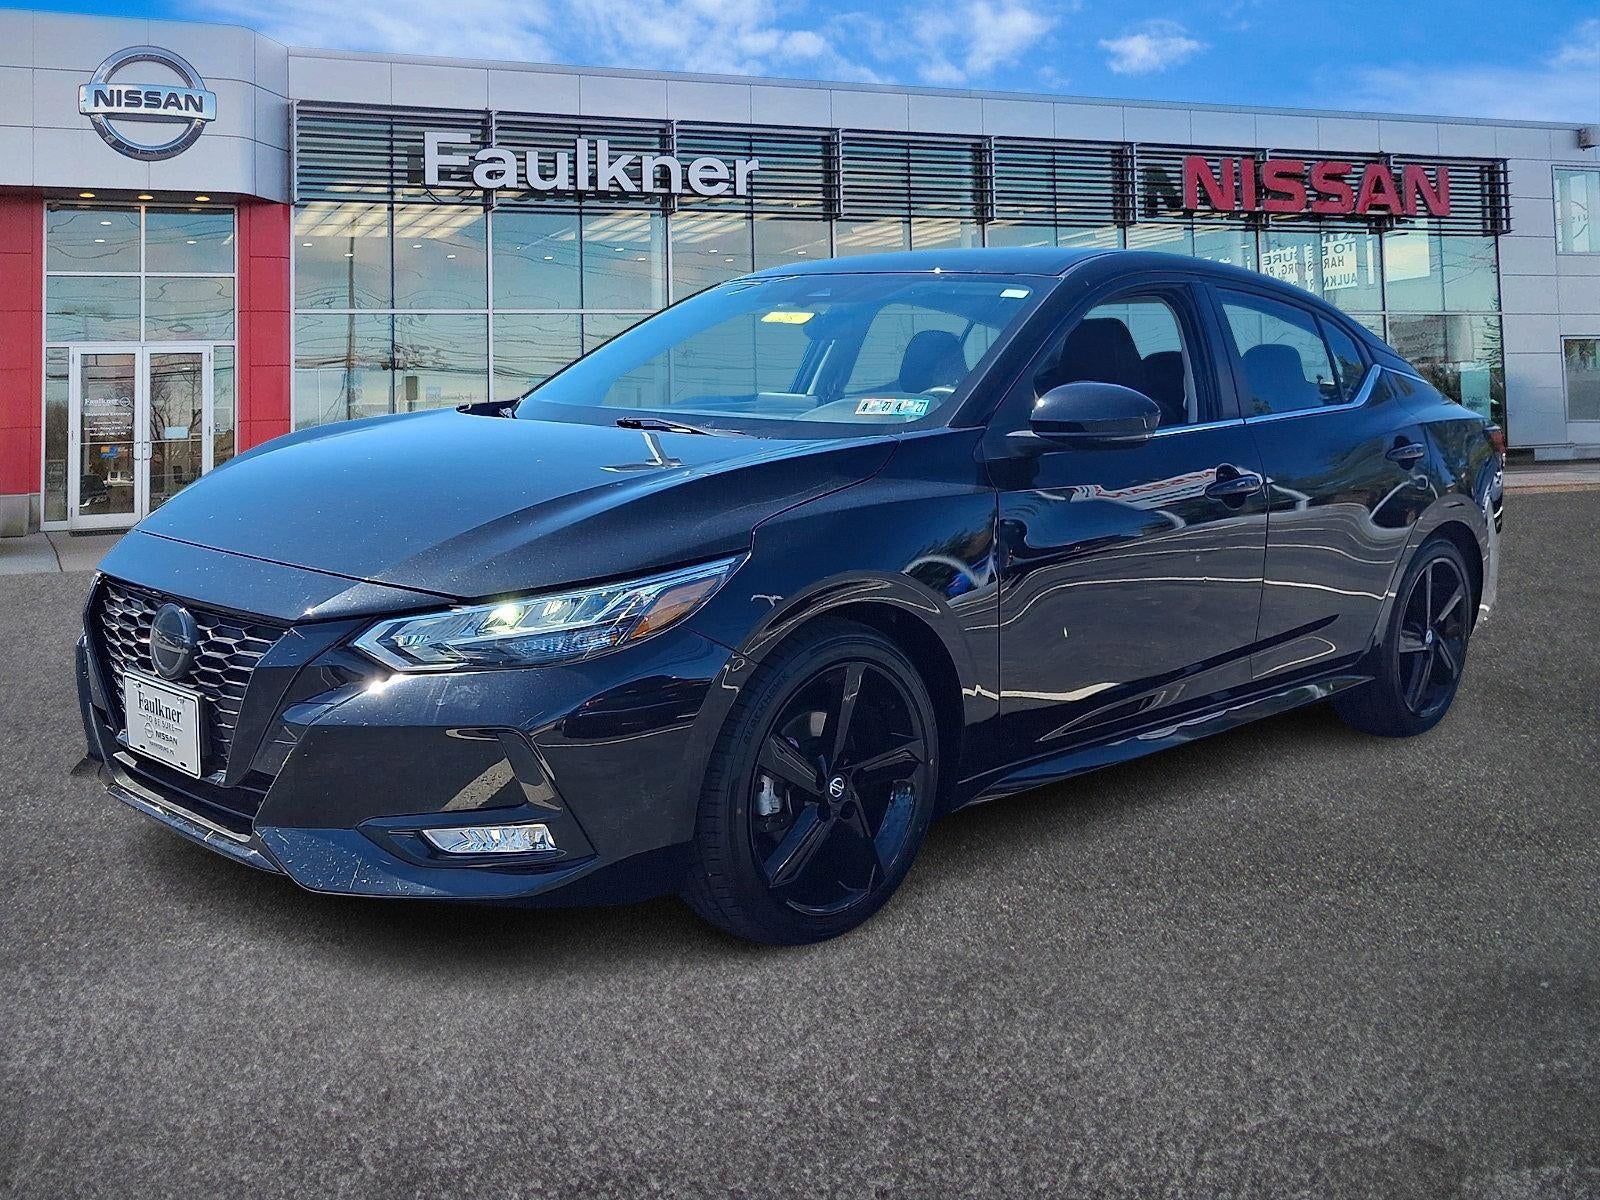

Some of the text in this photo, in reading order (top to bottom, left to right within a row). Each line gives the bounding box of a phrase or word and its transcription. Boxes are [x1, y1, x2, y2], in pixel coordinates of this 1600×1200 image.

[93, 89, 204, 113] NISSAN
[423, 131, 760, 196] Faulkner
[1182, 155, 1450, 216] NISSAN
[137, 690, 182, 724] Faulkner
[155, 730, 178, 746] NISSAN
